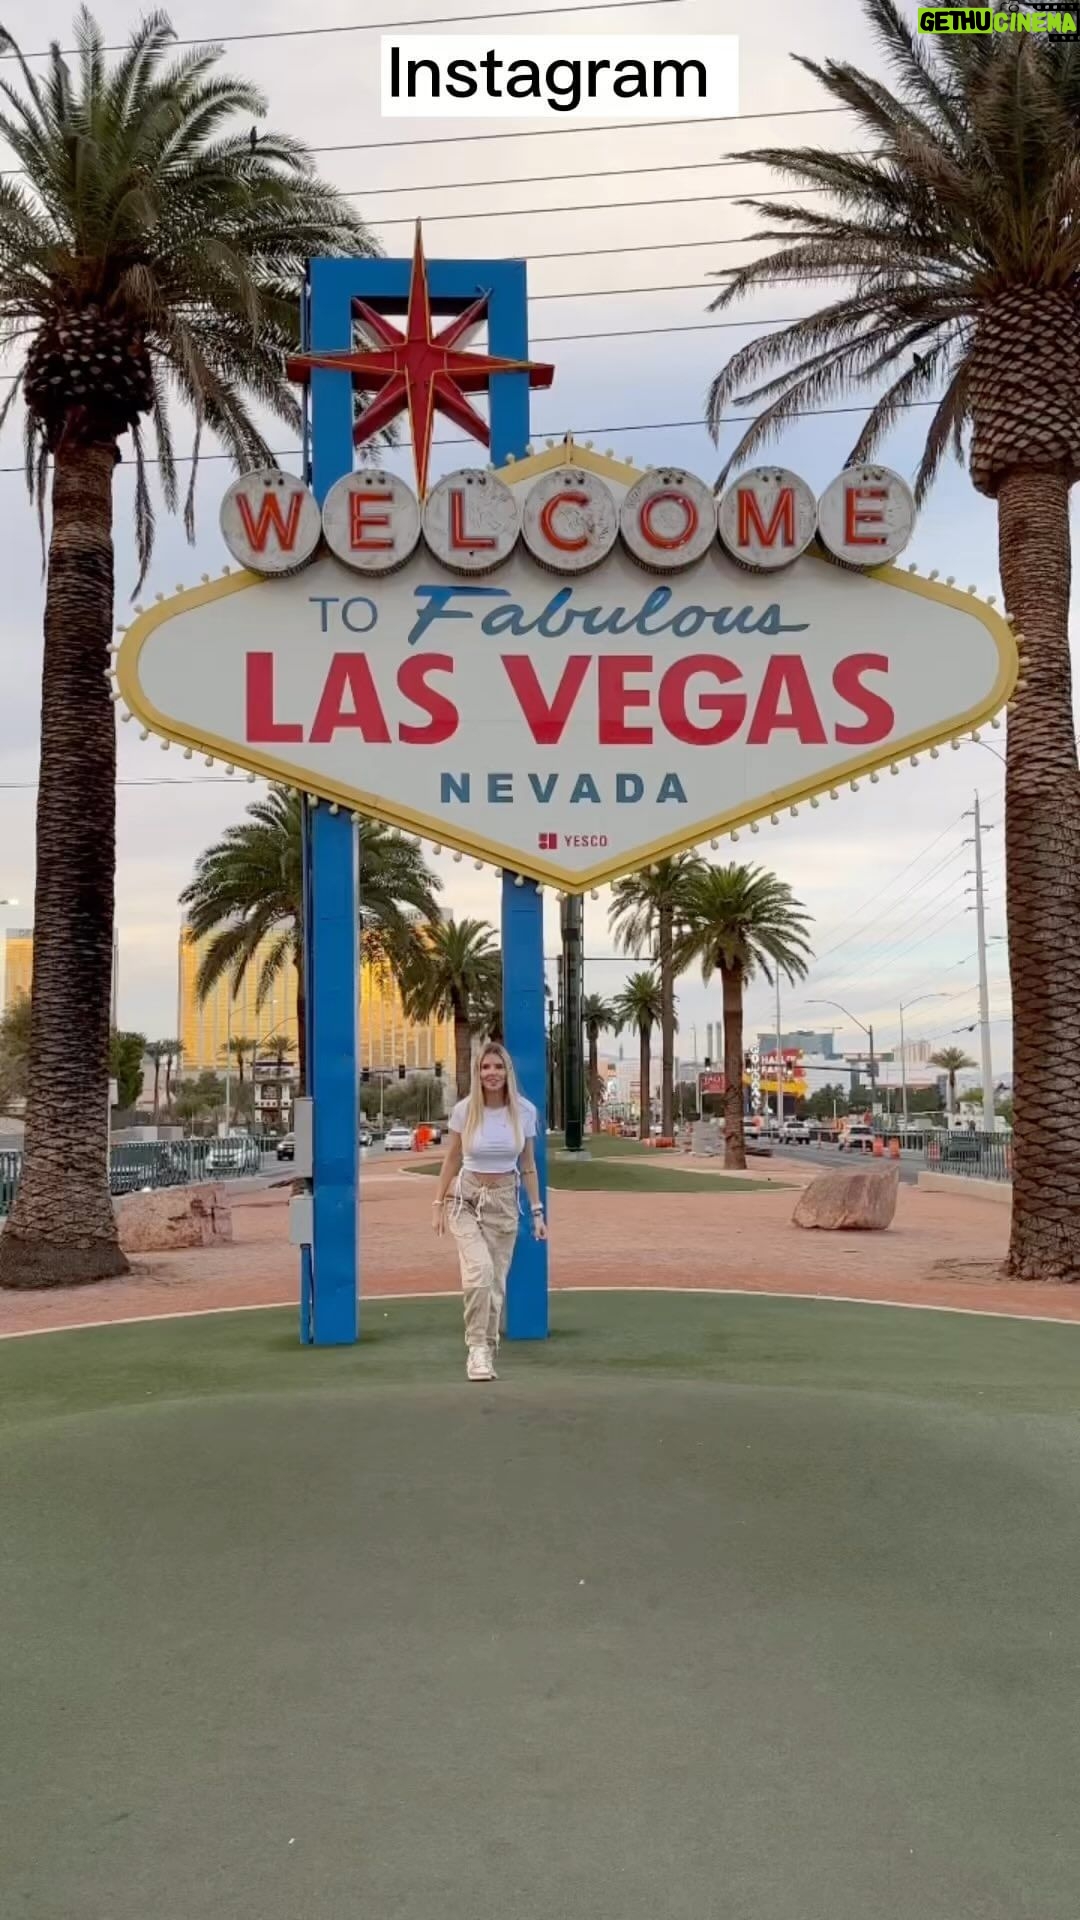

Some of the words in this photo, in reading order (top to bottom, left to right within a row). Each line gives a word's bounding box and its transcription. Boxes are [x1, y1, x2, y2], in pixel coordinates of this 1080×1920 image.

[236, 488, 889, 553] WELCOME
[309, 596, 379, 633] TO
[407, 584, 810, 646] Fabulous
[245, 651, 460, 744] LAS
[501, 652, 895, 746] VEGAS
[440, 772, 689, 804] NEVADA
[563, 834, 608, 848] YESCO
